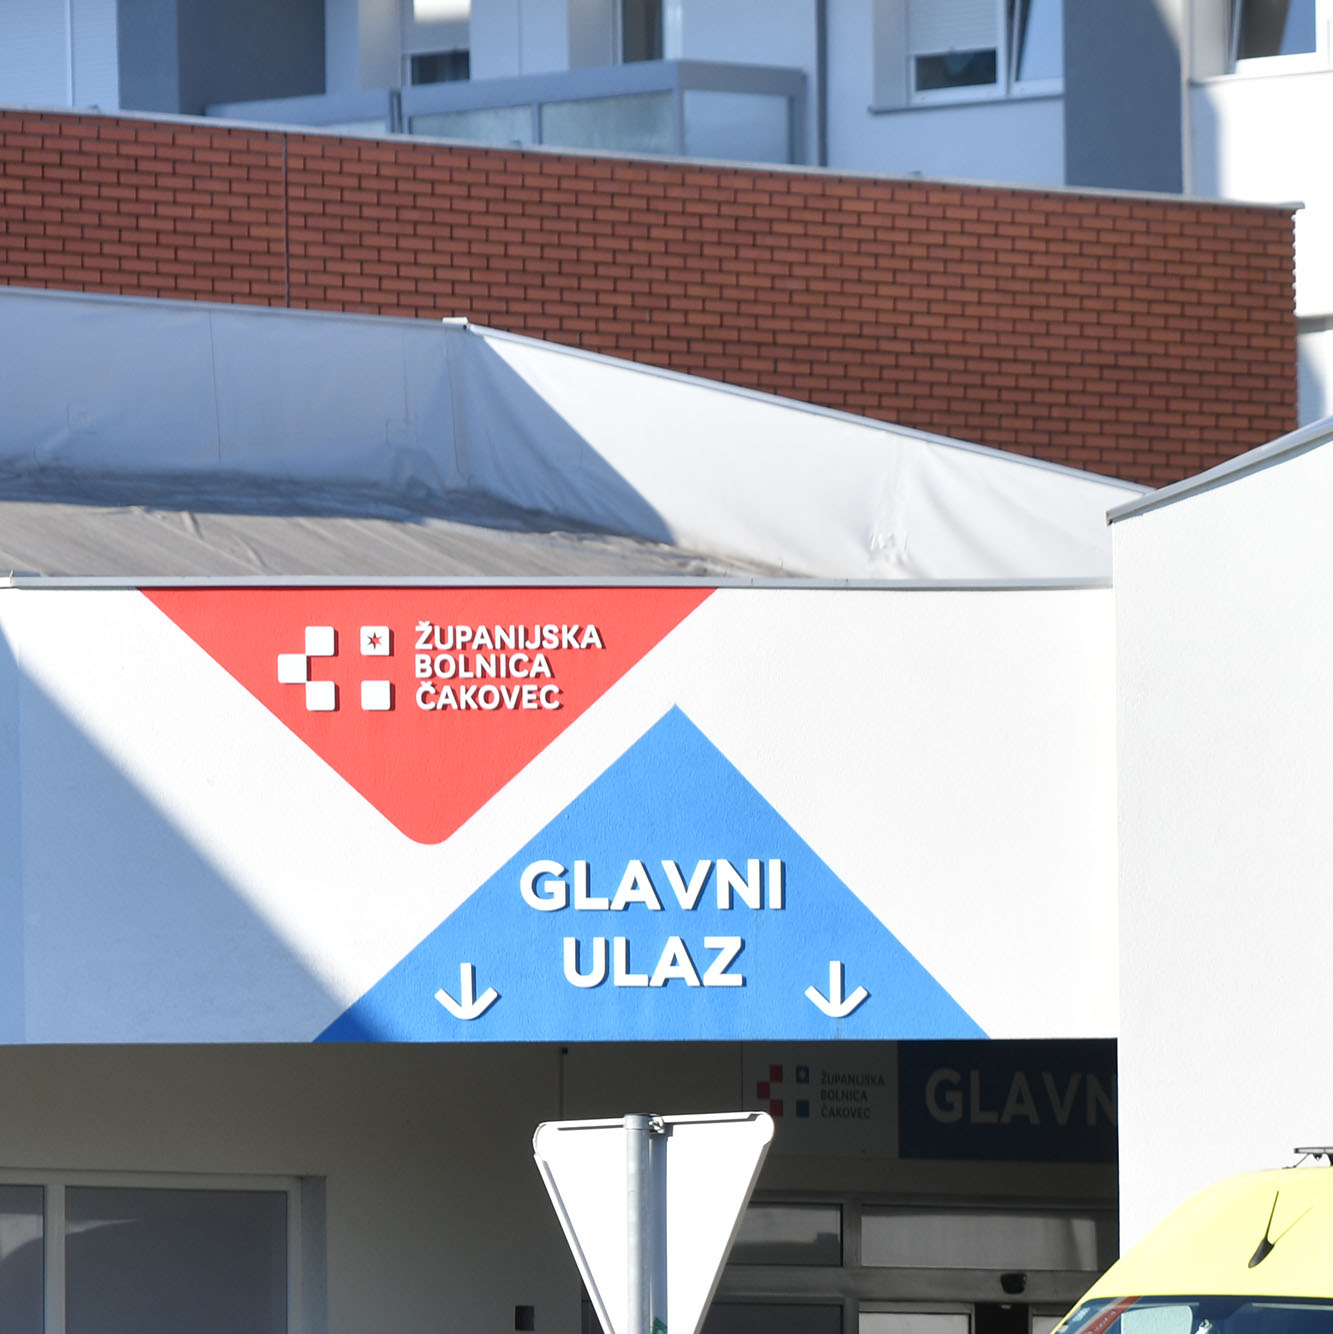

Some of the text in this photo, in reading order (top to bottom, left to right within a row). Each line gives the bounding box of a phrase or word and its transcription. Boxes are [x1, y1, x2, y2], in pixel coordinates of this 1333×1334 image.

[415, 620, 604, 650] ŽUPANIJSKA
[415, 653, 554, 678] BOLNICA
[415, 680, 562, 711] ČAKOVEC
[519, 858, 786, 913] GLAVNI
[562, 935, 746, 988] ULAZ
[820, 1070, 885, 1087] ŽUPANIJSKA
[820, 1089, 868, 1102] BOLNICA
[925, 1067, 1118, 1127] GLAVN
[820, 1105, 871, 1119] ČAKOVEC
